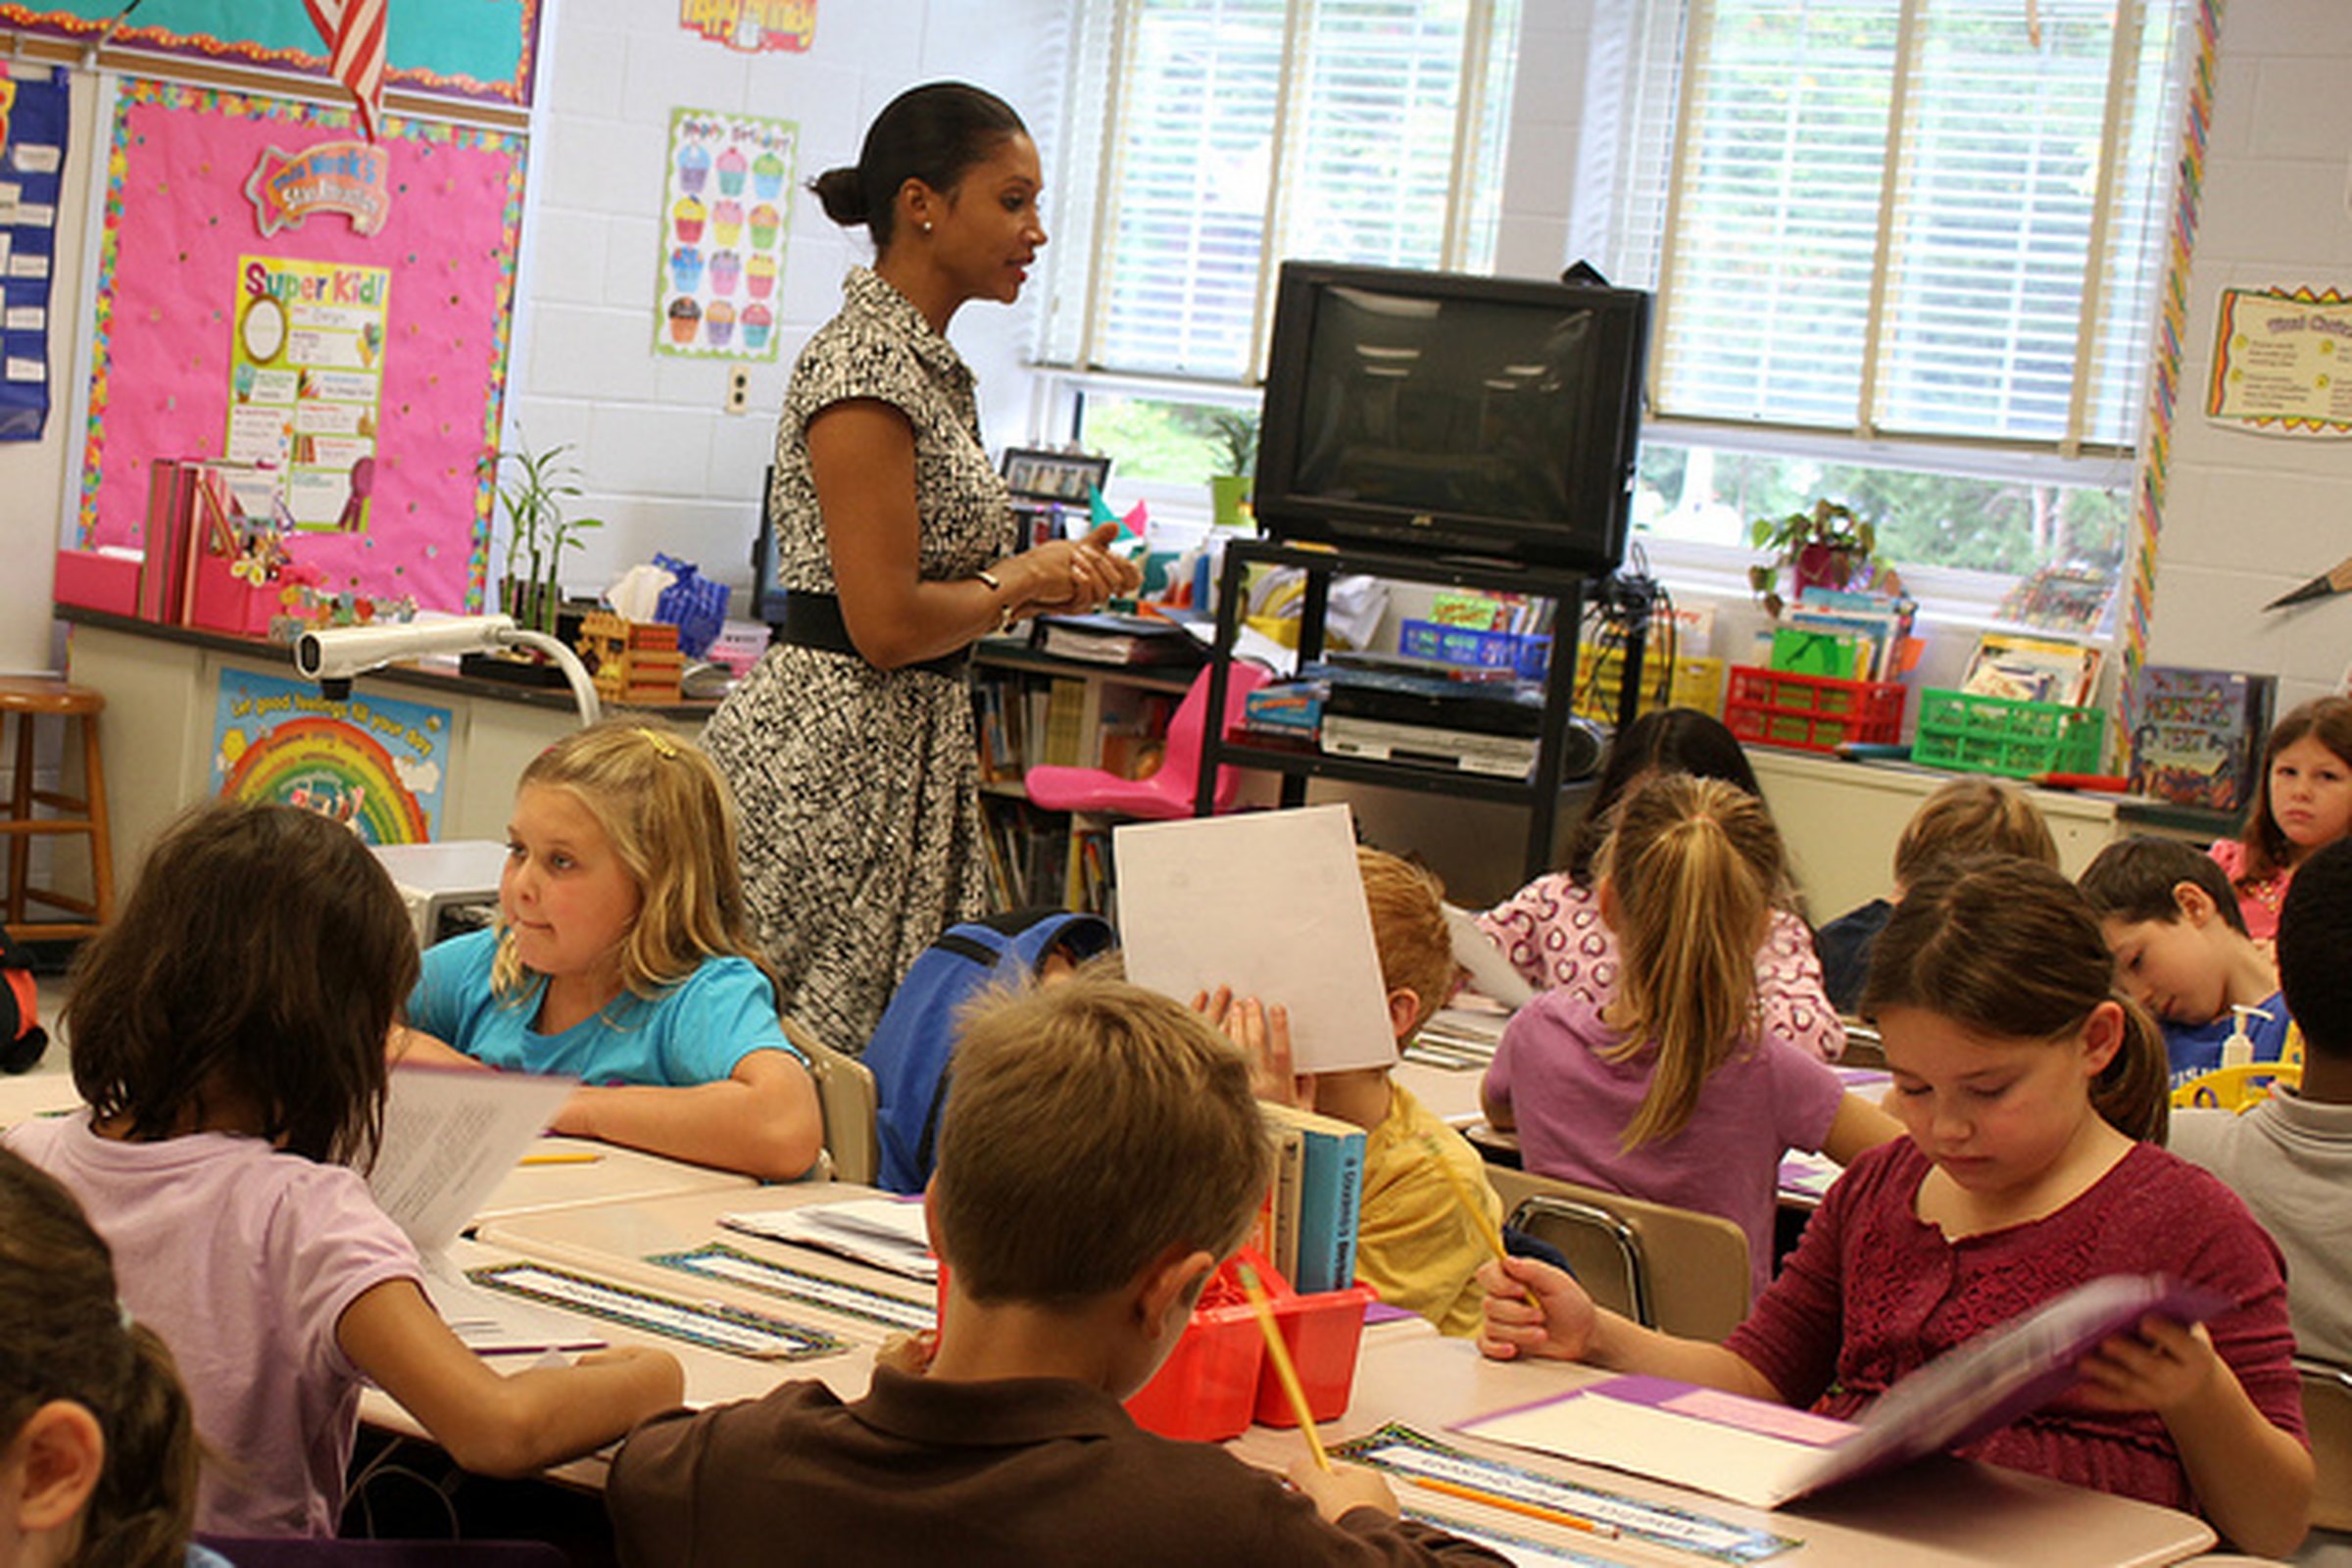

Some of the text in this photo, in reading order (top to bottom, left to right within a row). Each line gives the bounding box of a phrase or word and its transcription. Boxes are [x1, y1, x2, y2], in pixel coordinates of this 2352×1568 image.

[245, 261, 387, 308] Super Kid!
[256, 691, 292, 716] good
[406, 728, 433, 758] day
